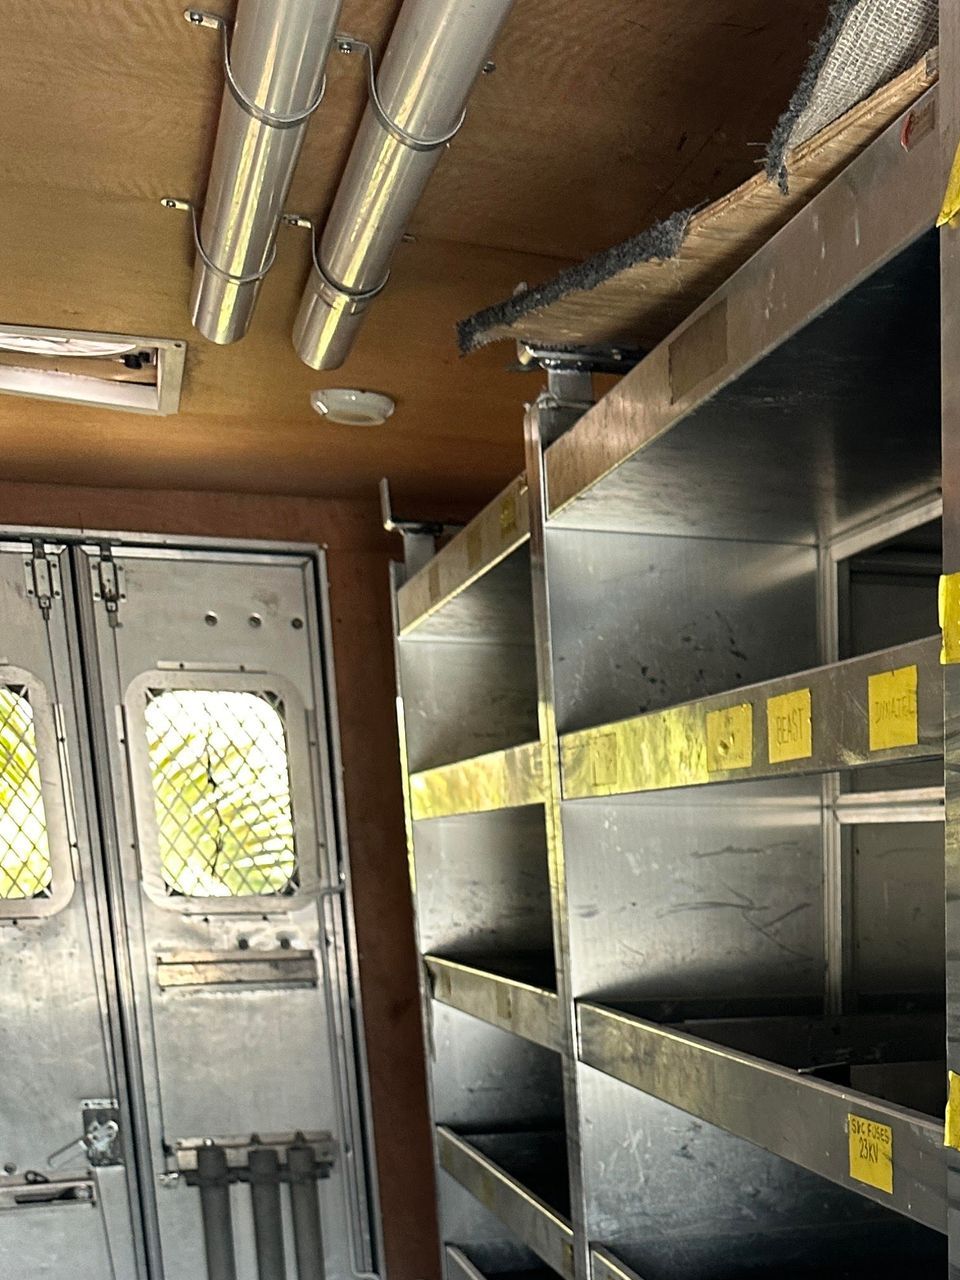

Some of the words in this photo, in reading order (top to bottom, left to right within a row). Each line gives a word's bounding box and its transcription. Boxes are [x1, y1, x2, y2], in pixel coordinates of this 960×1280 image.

[774, 707, 805, 745] BEAST
[866, 1123, 890, 1145] FUSES
[859, 1136, 879, 1163] 23KV
